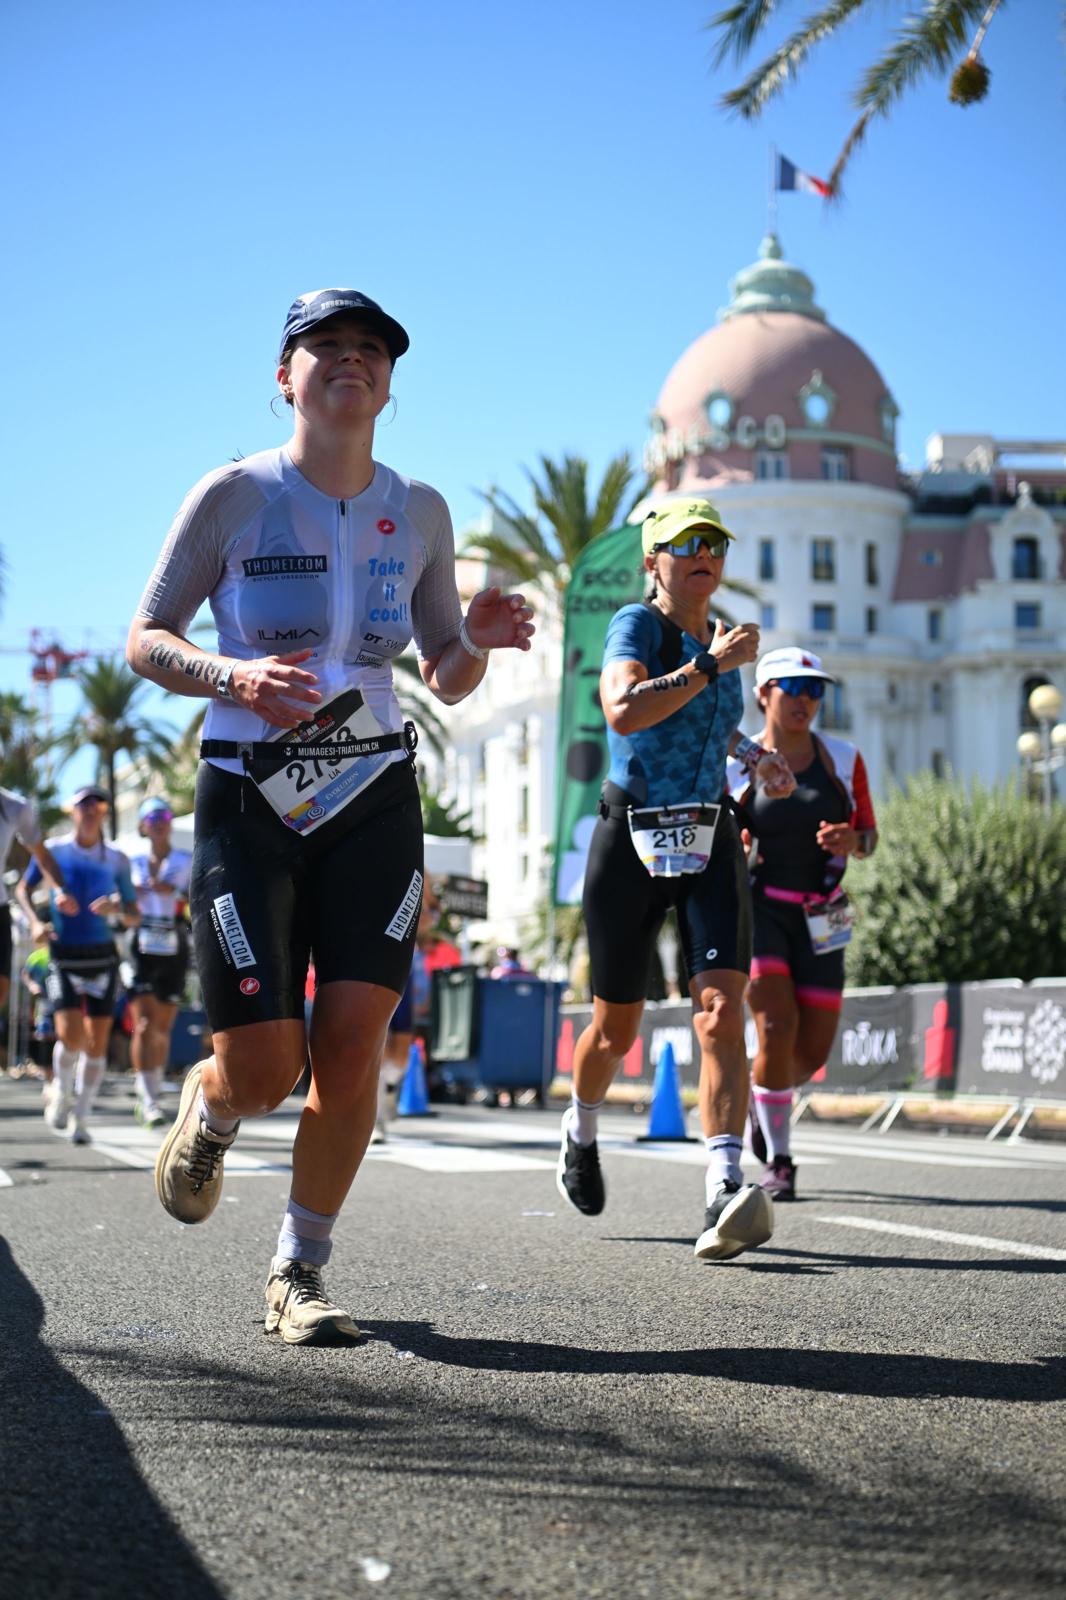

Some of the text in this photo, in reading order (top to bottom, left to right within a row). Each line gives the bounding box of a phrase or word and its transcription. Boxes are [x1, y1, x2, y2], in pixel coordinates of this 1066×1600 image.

[246, 557, 325, 575] THOMET.COM
[368, 556, 405, 577] Take
[384, 582, 396, 602] it
[363, 632, 383, 645] DT
[297, 741, 380, 757] MUMAGESI-TRIATHLON.CH
[328, 768, 342, 781] LIA
[389, 873, 422, 937] THOMET.COM
[210, 907, 233, 966] BICYCLE OBSESSION
[217, 896, 253, 966] THOMET.COM
